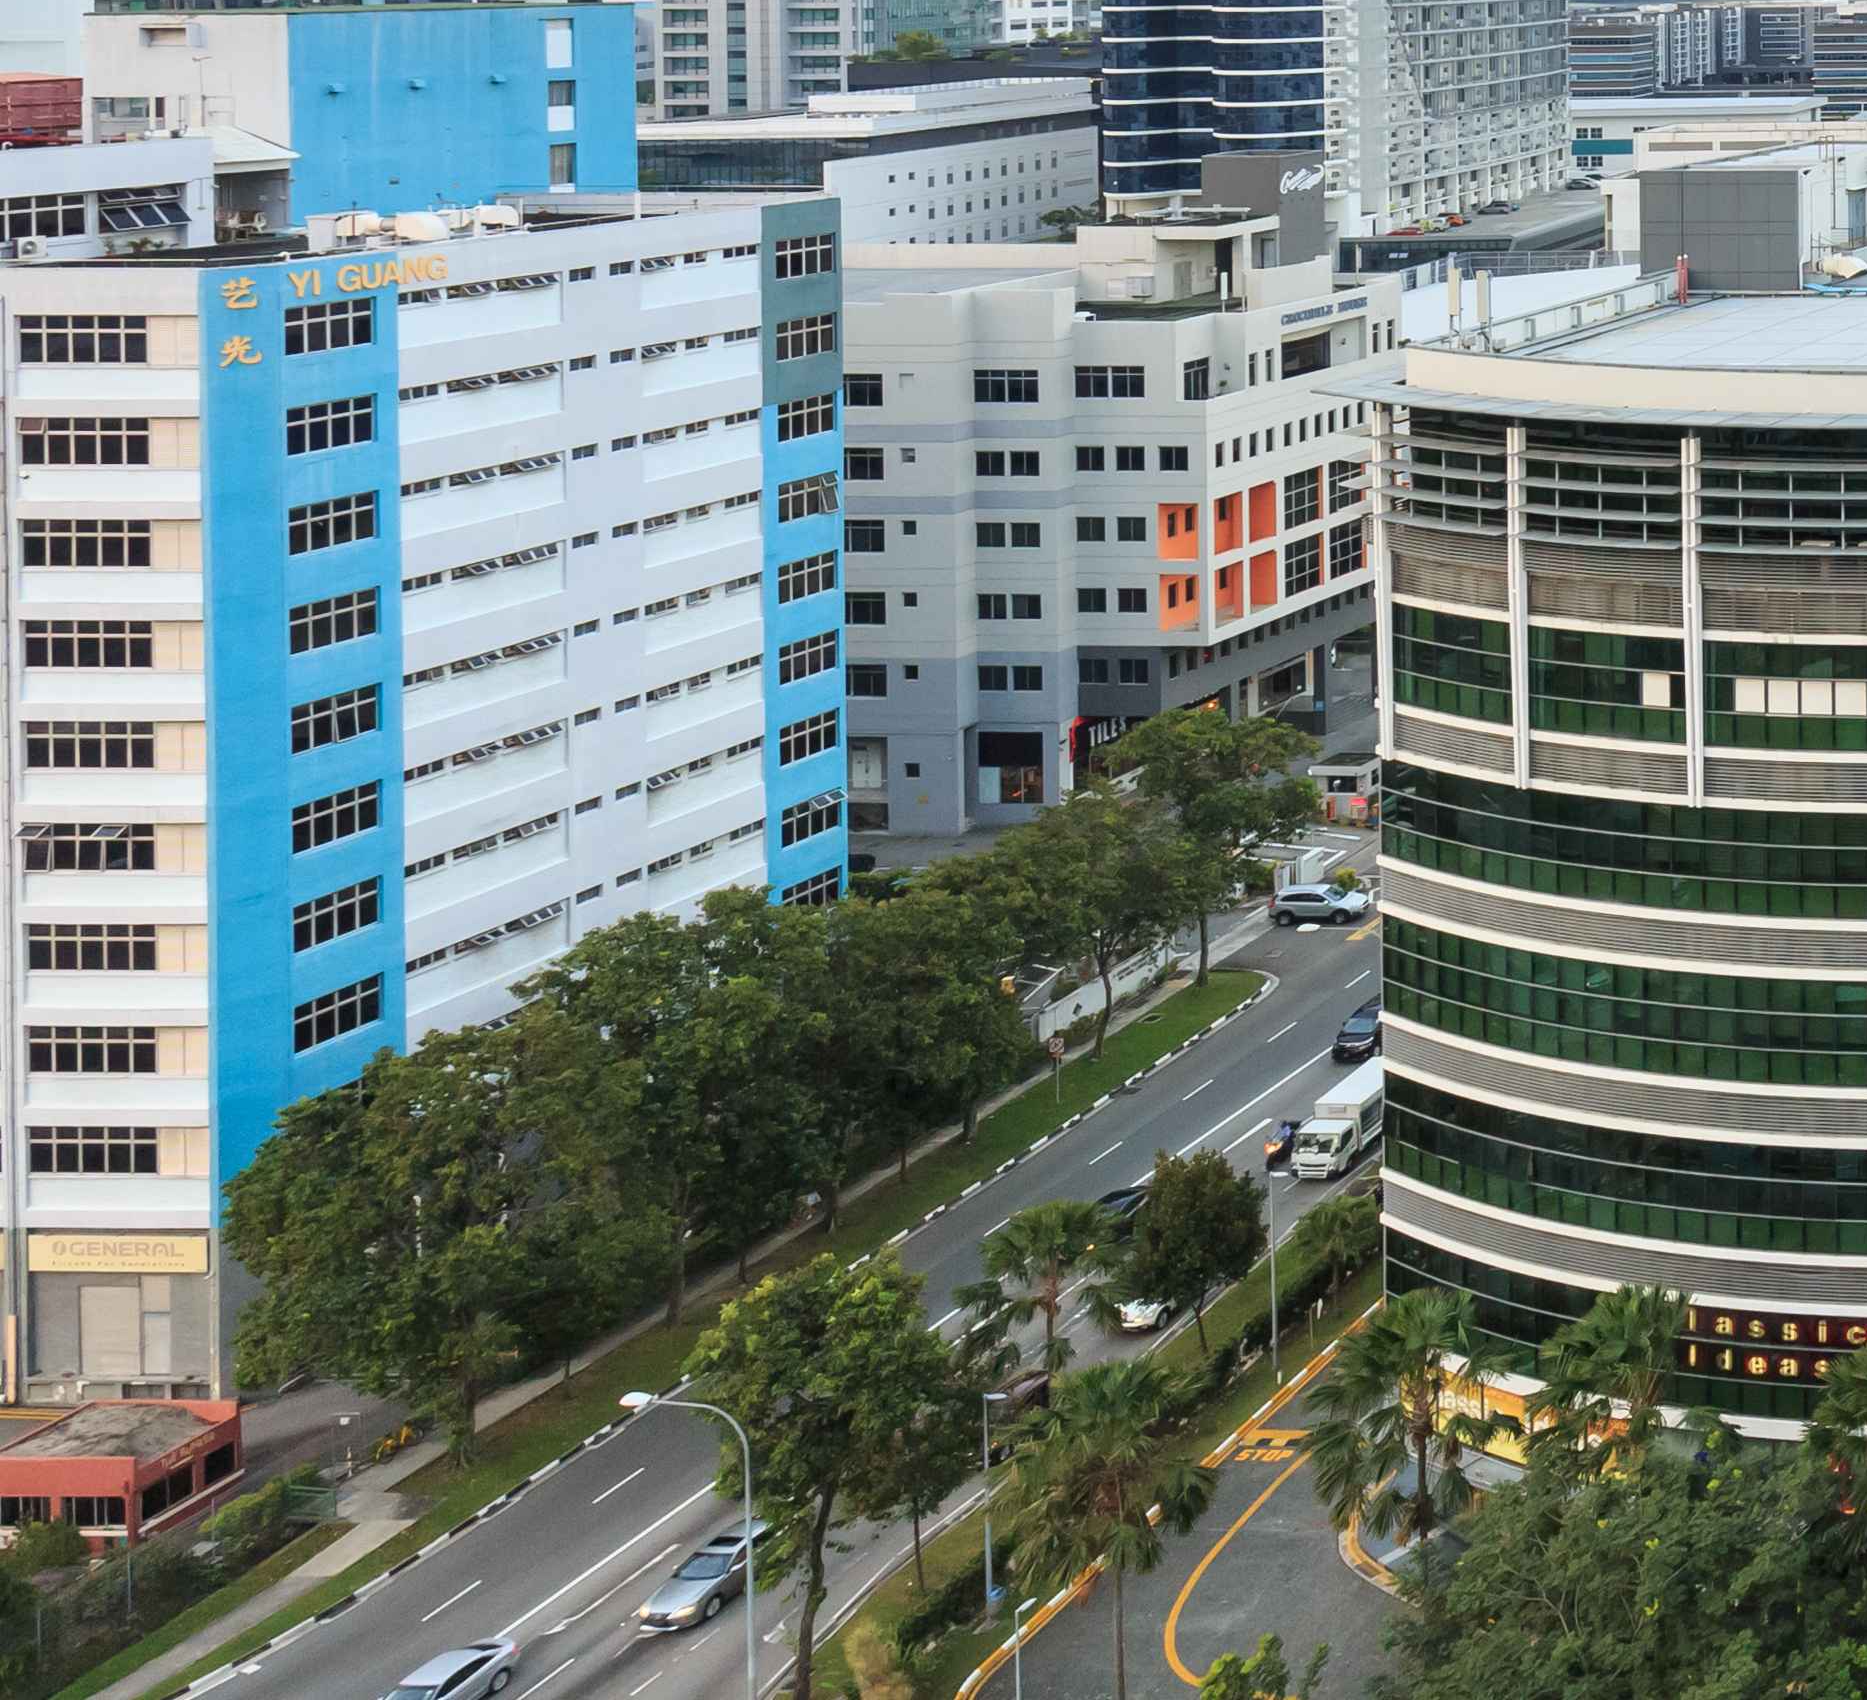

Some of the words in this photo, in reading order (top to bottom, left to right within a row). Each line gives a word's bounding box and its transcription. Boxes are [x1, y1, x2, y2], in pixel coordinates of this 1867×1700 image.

[288, 268, 321, 298] YI
[336, 253, 449, 293] GUANG
[69, 1241, 185, 1257] GENERAL
[1232, 1447, 1296, 1462] STOP
